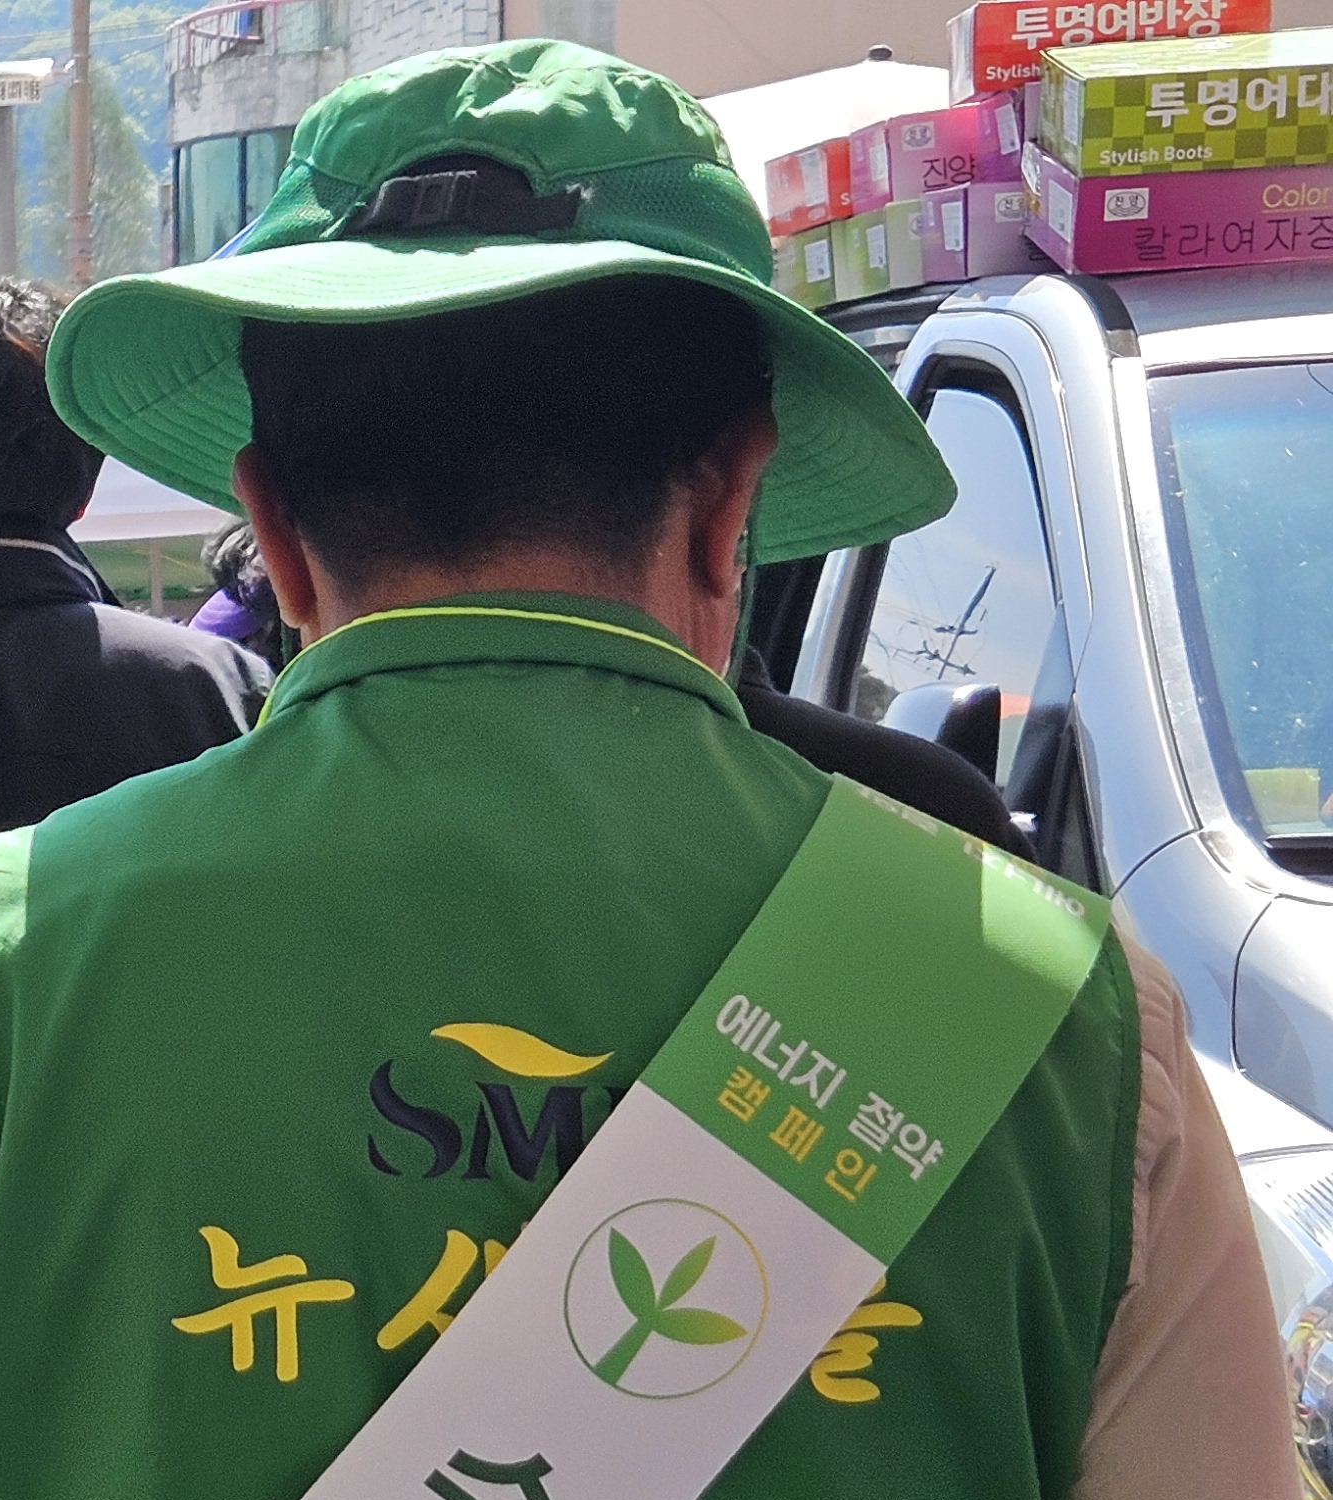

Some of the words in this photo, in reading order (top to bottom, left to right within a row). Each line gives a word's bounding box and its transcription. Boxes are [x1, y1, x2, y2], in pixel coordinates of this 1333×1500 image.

[1012, 0, 1228, 50] 투명여반장
[986, 64, 1040, 81] Stylish
[921, 153, 976, 188] 진양
[1100, 147, 1159, 166] Stylish
[1164, 146, 1213, 161] Boots
[1263, 183, 1330, 208] Color
[716, 994, 847, 1109] 에너지
[847, 1090, 944, 1181] 절약
[367, 1059, 625, 1181] SM
